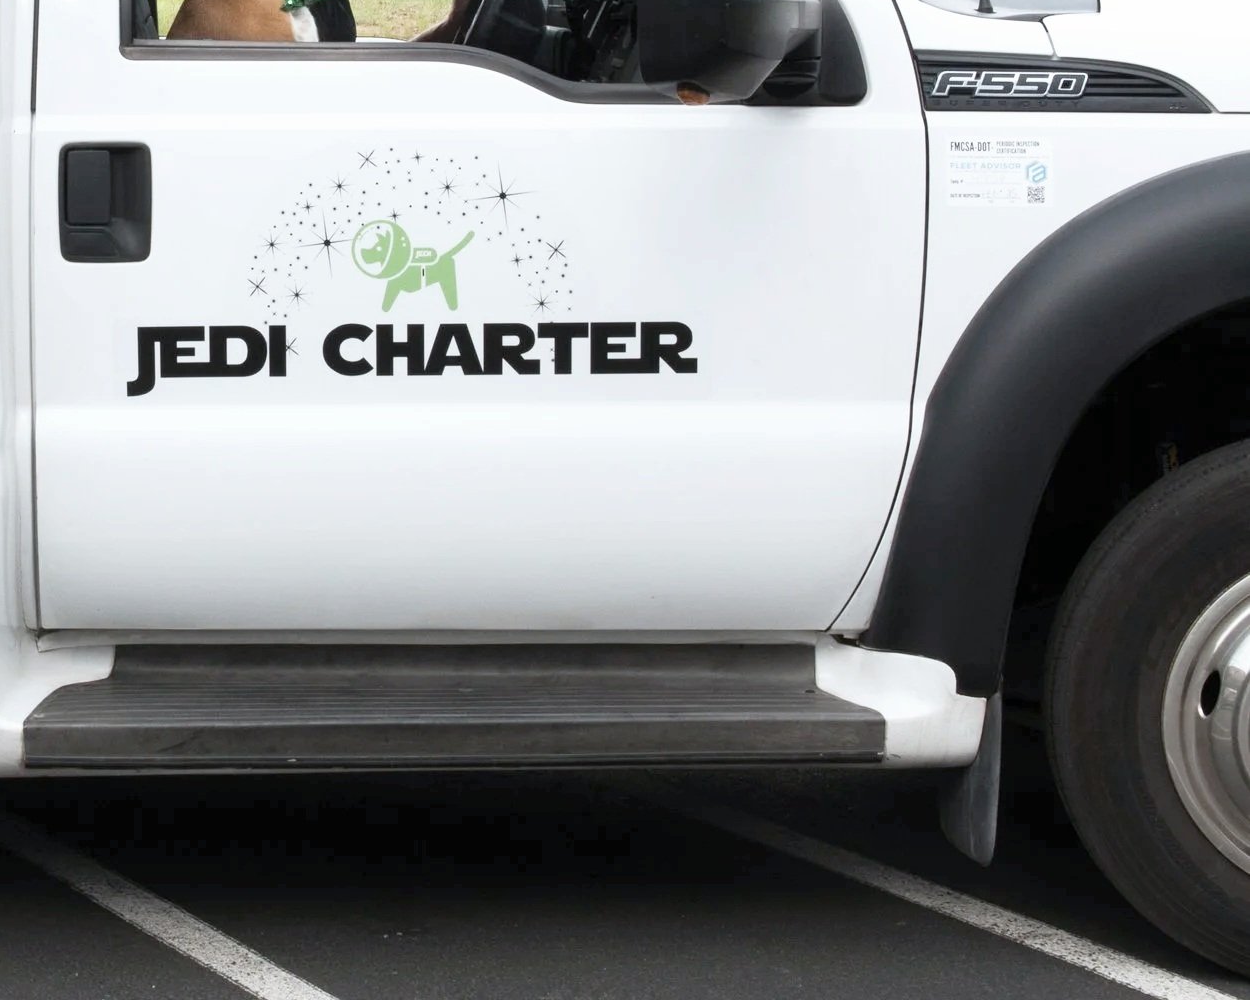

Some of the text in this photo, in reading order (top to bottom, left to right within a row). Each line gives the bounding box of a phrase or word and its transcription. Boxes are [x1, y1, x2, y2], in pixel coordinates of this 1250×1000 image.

[931, 70, 1088, 98] F-550
[126, 321, 698, 397] JEDI CHARTER
